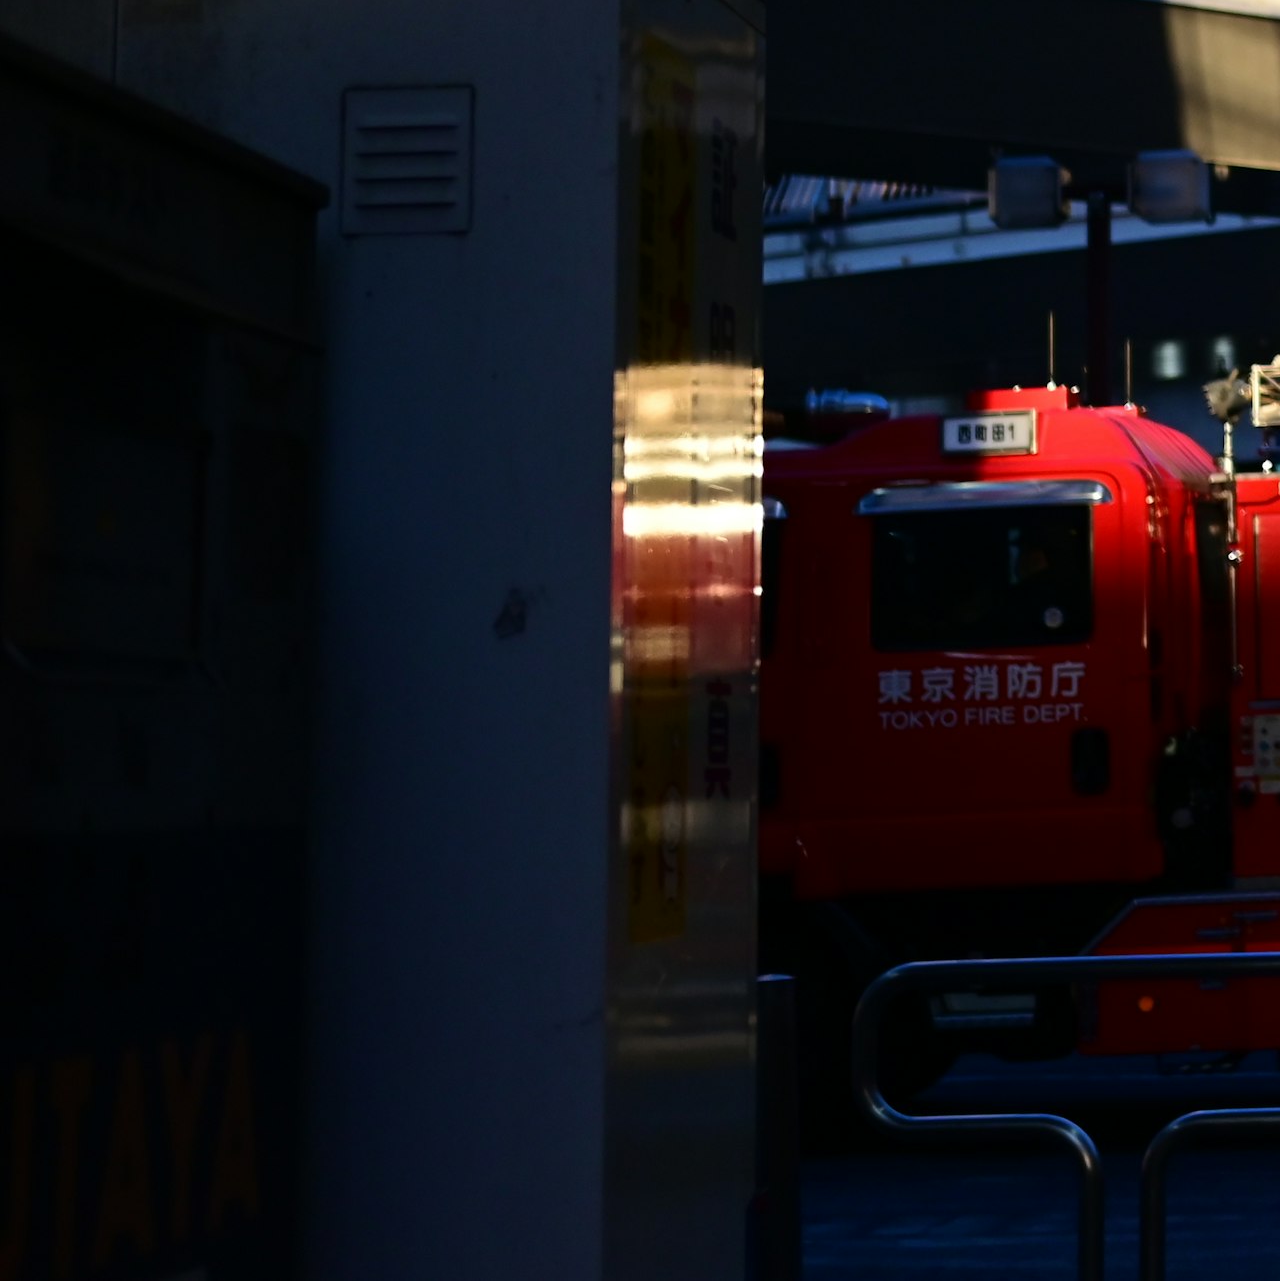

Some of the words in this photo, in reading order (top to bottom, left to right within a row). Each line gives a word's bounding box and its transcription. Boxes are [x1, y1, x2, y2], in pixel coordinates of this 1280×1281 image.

[877, 661, 1087, 705] 東京消防庁
[878, 708, 958, 730] TOKYO
[964, 706, 1016, 727] FIRE
[1022, 702, 1089, 725] DEPT.
